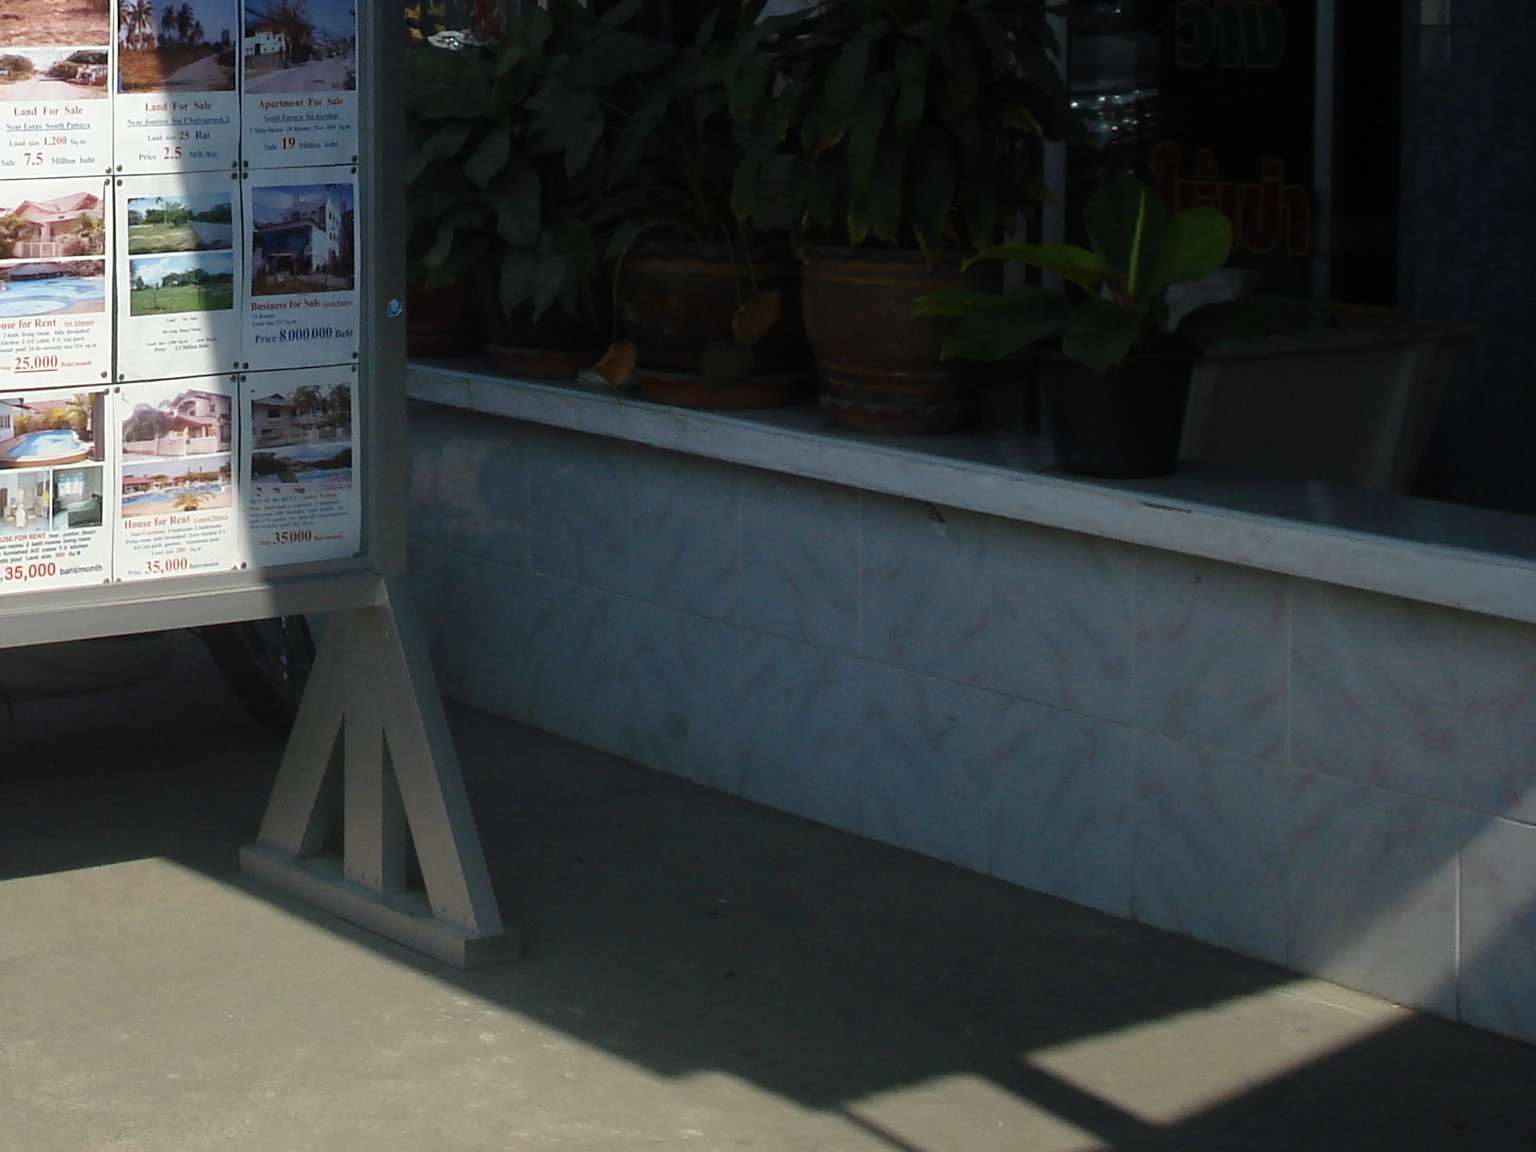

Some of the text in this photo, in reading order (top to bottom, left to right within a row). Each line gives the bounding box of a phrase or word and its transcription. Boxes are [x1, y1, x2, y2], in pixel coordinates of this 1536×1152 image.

[172, 101, 211, 111] For Sale
[259, 98, 343, 109] Apartment Sale
[14, 106, 83, 116] Land For Sale
[195, 131, 210, 139] Rai
[282, 137, 296, 149] 19
[24, 153, 43, 166] 7.5
[164, 147, 182, 160] 2.5
[18, 320, 32, 328] for
[34, 319, 56, 328] Rent
[124, 516, 191, 529] House for Rent
[4, 563, 56, 581] 35,000
[145, 558, 188, 574] 35,000
